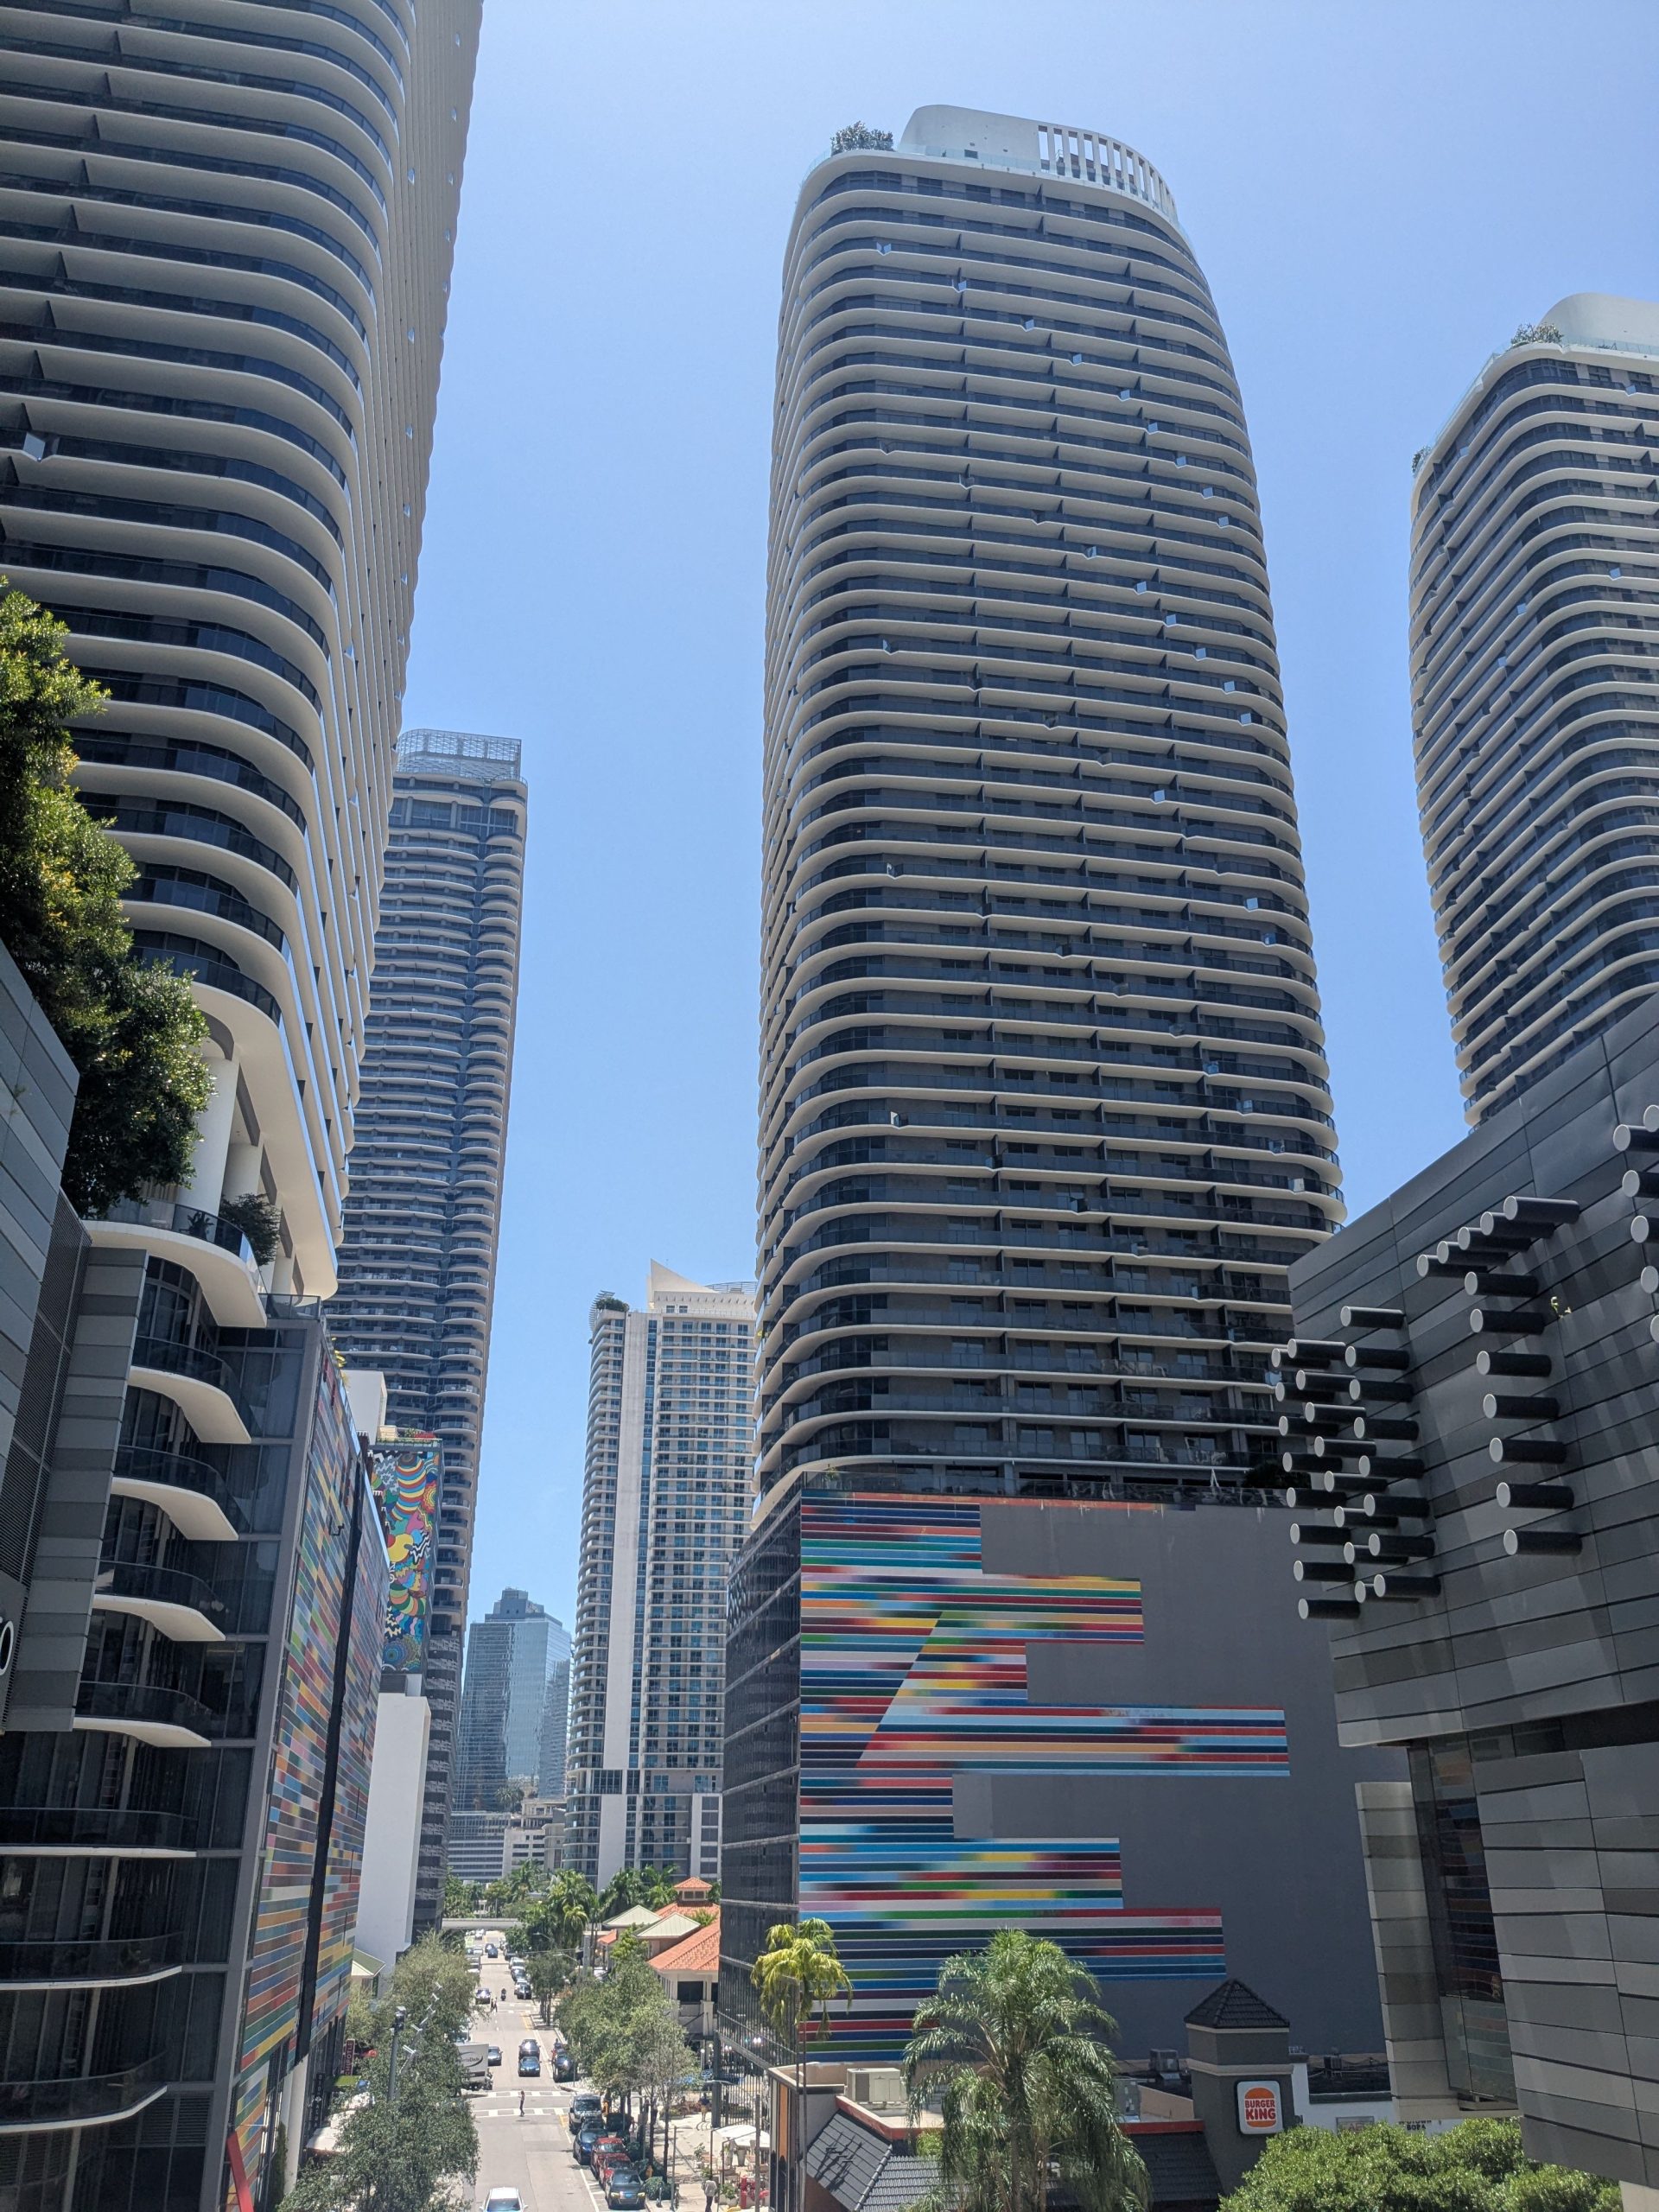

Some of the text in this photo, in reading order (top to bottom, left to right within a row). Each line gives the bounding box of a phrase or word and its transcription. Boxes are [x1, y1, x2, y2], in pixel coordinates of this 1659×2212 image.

[345, 2041, 353, 2075] CHIPOTLE
[1244, 2100, 1275, 2108] BURGER
[1245, 2108, 1276, 2120] KING
